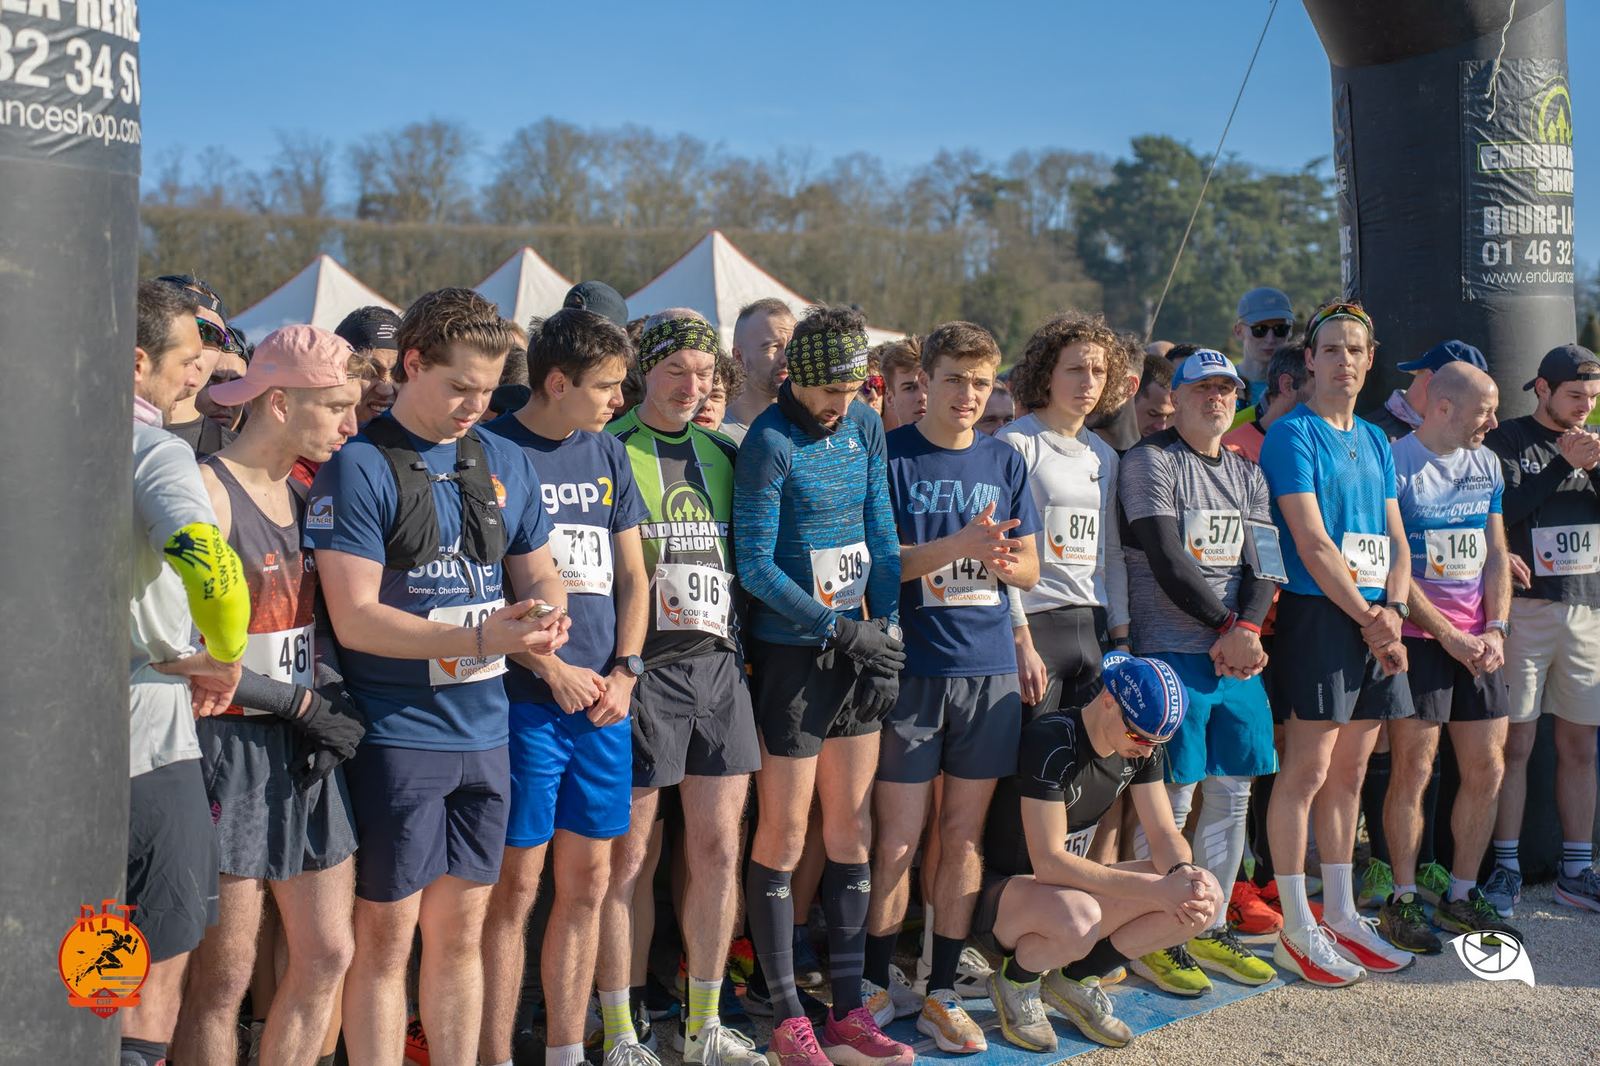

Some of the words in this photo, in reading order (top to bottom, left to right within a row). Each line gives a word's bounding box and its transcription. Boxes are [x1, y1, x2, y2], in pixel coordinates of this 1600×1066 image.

[65, 38, 114, 99] 34
[1480, 144, 1573, 169] ENDURA
[1483, 205, 1574, 236] BOURG-LA-
[1482, 241, 1512, 265] 01
[1525, 240, 1550, 265] 46
[1556, 240, 1571, 265] 32
[540, 477, 613, 514] gap2
[640, 521, 730, 538] NDURANC
[1070, 514, 1095, 540] 874
[1209, 516, 1240, 544] 577
[668, 537, 715, 551] SHOP
[1448, 534, 1477, 559] 148
[1556, 531, 1591, 553] 904
[839, 551, 862, 582] 918
[204, 577, 215, 600] TCS
[688, 572, 719, 605] 916
[279, 632, 311, 675] 461
[1124, 675, 1146, 710] GAZETTE
